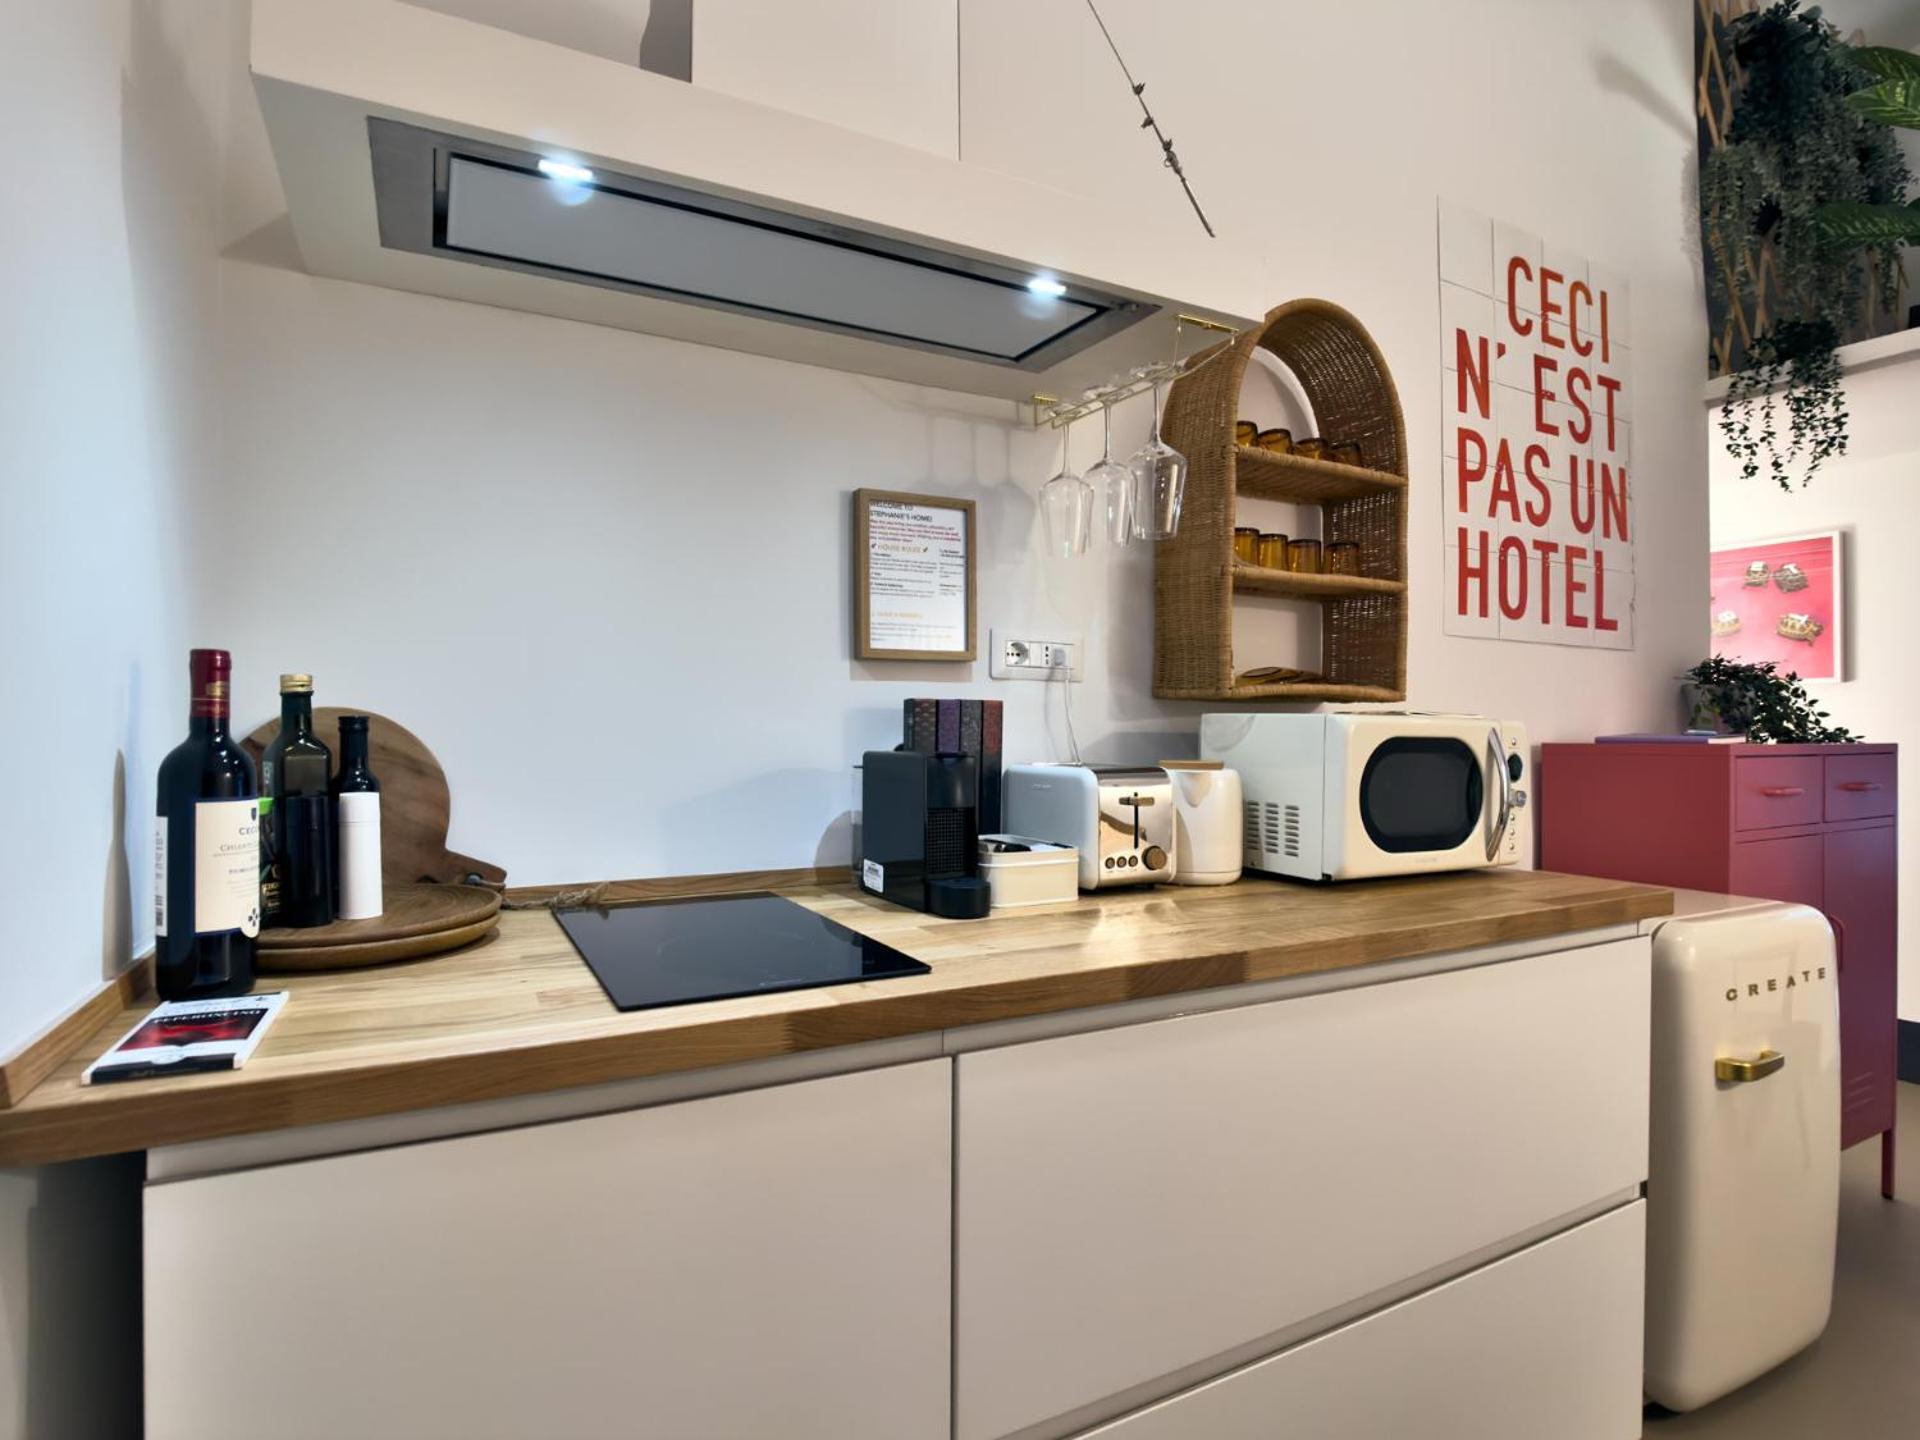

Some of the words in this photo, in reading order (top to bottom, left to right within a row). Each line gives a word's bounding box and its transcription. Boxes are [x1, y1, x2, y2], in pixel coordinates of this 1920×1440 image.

[1507, 256, 1609, 364] CECI
[1534, 353, 1621, 452] EST
[1457, 427, 1551, 527] PAS
[1569, 454, 1629, 543] UN
[1457, 527, 1619, 631] HOTEL
[1726, 967, 1825, 1001] CREATE
